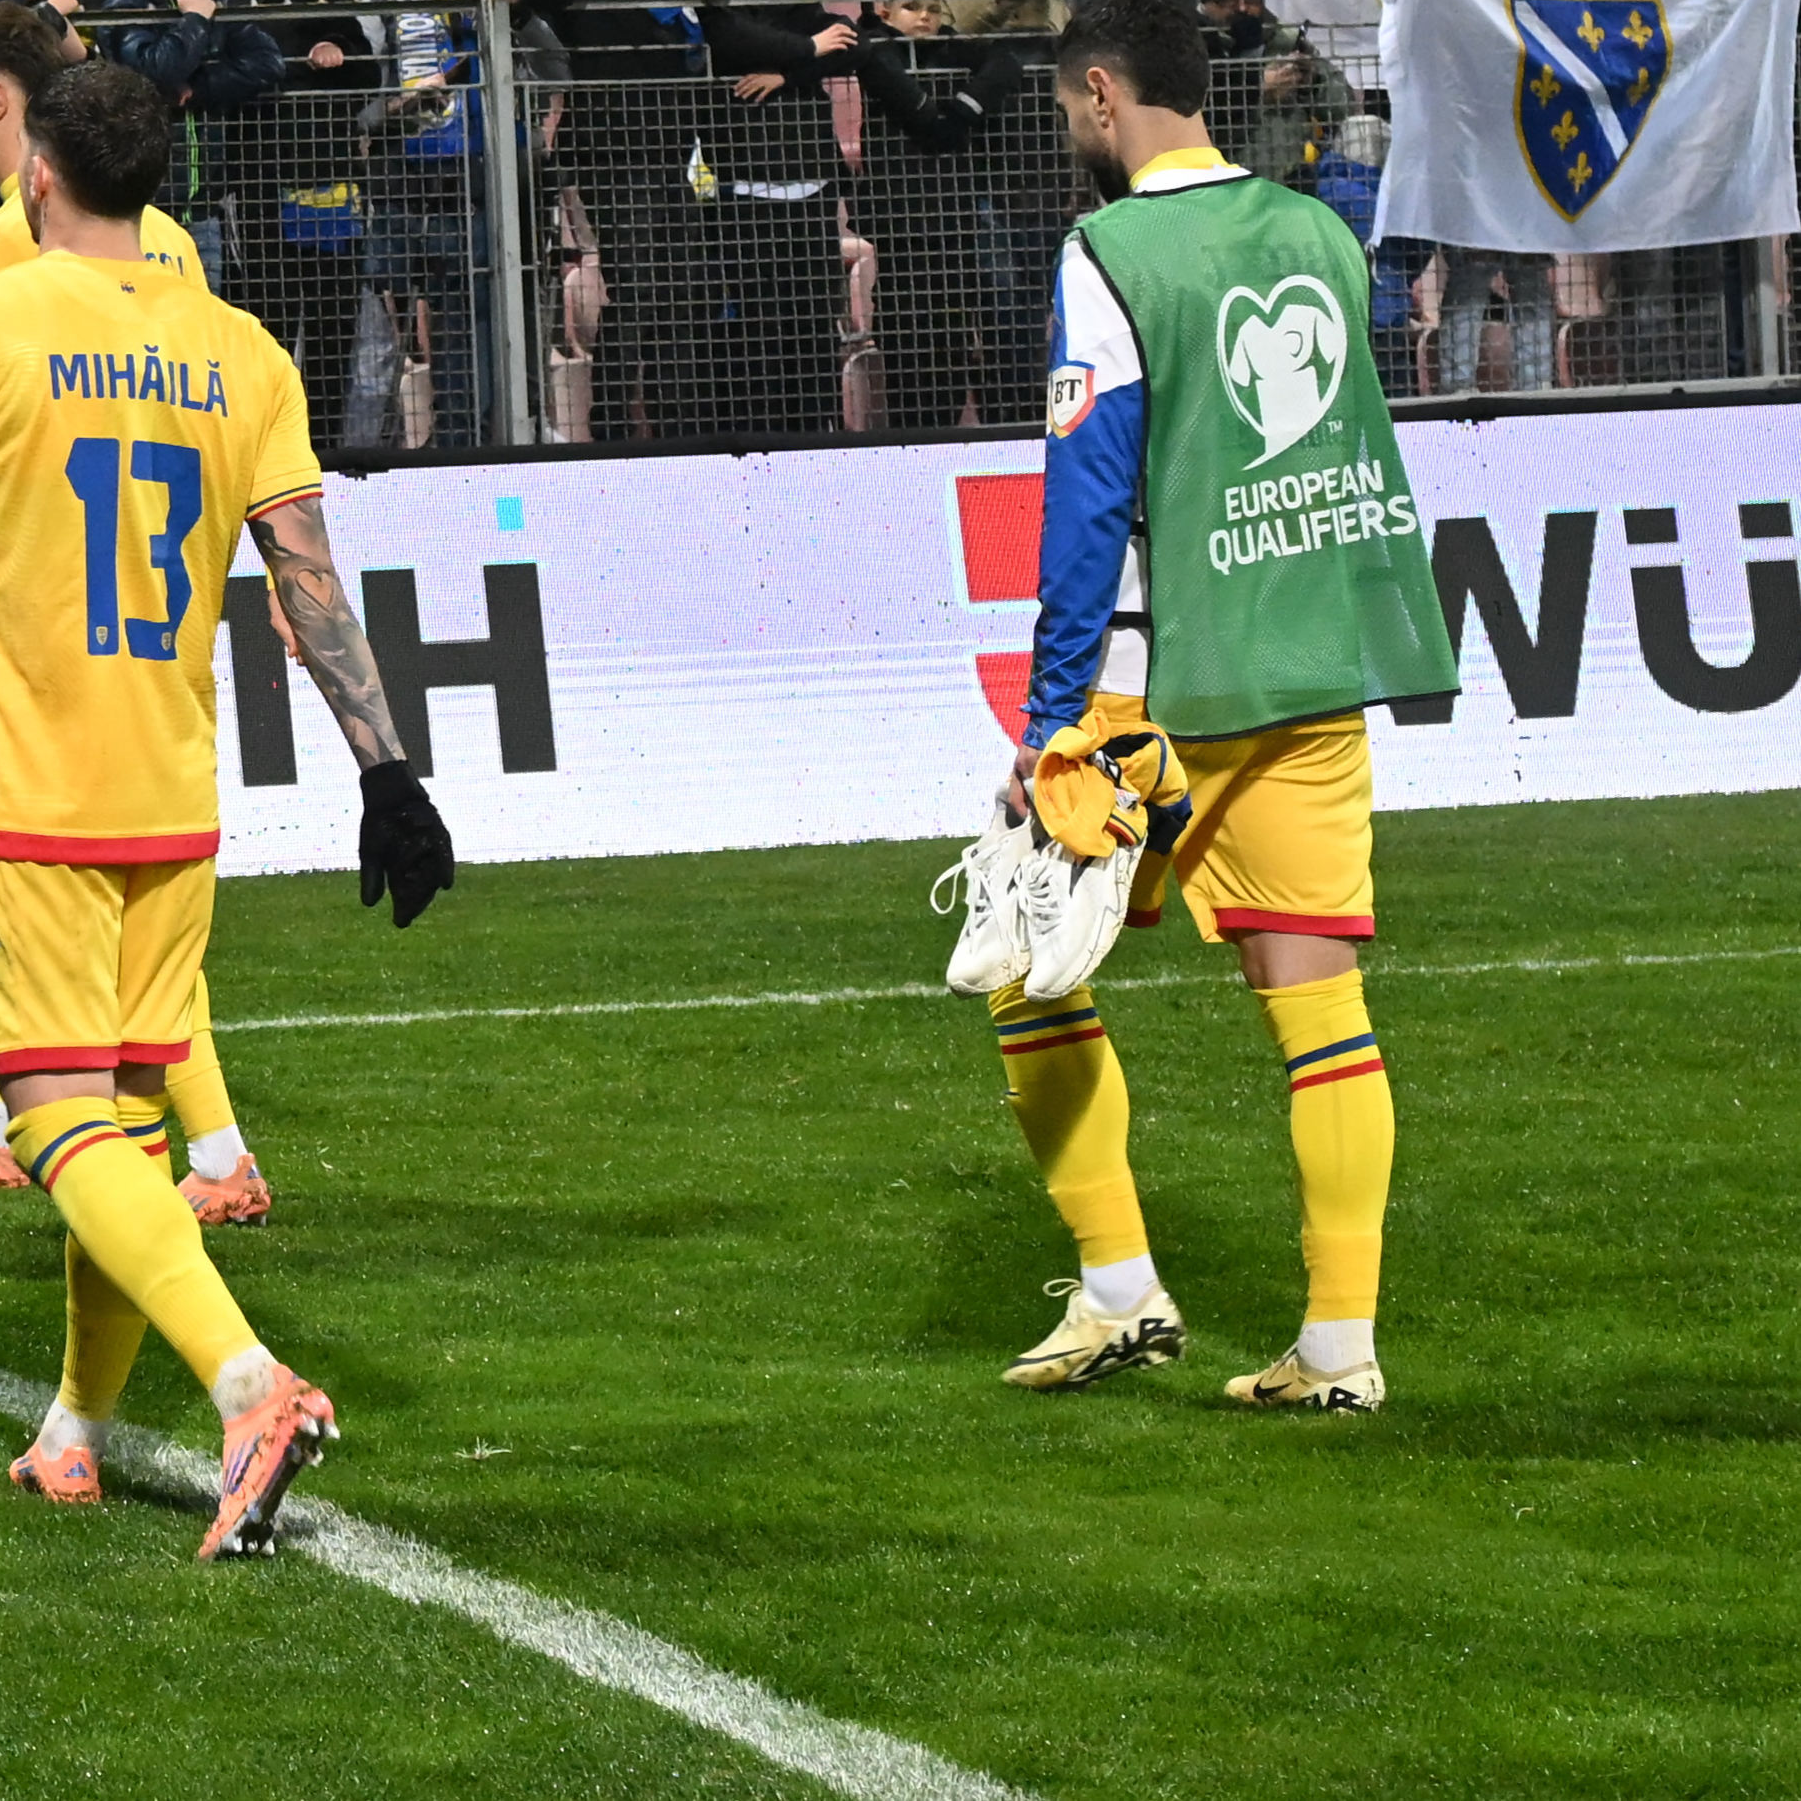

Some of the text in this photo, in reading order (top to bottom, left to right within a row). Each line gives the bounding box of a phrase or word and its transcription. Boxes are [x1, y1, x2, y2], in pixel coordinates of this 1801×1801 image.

[48, 343, 228, 419] MIHĂILĂ
[1054, 378, 1083, 405] BT
[1224, 459, 1385, 522] EUROPEAN
[64, 436, 204, 662] 13
[1208, 495, 1417, 576] QUALIFIERS
